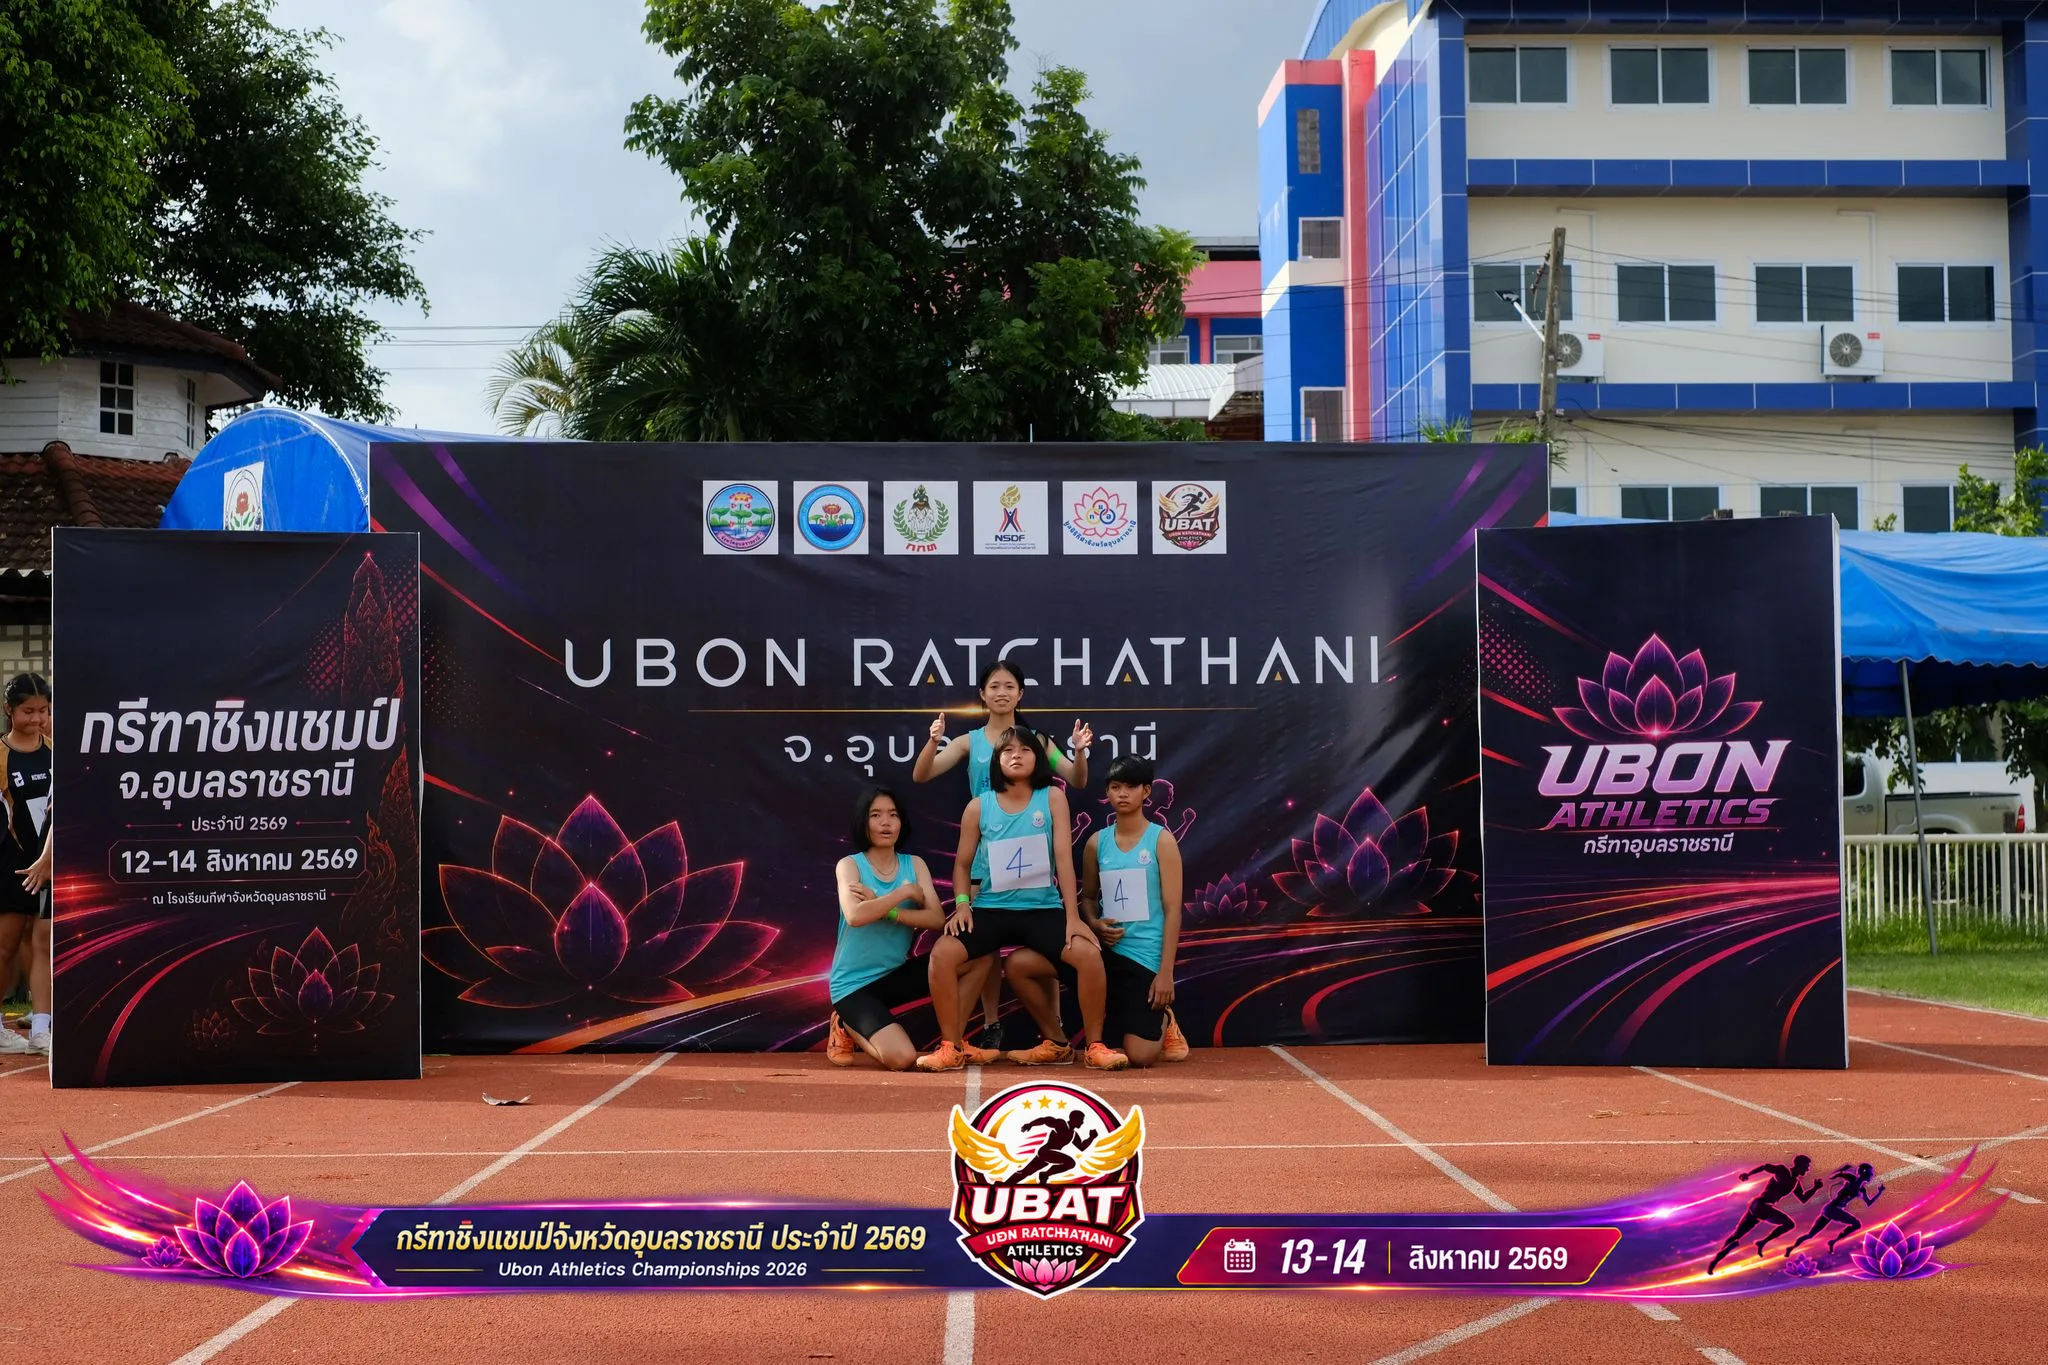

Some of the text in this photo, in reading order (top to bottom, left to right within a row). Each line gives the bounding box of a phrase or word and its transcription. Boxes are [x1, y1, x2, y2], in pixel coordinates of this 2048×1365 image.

[994, 534, 1026, 542] NSDF
[1164, 518, 1215, 531] UBAT
[564, 636, 1380, 688] UBON RATCHATHANI
[1537, 739, 1793, 797] UBON
[191, 816, 288, 832] ประจำปี 2569
[1547, 798, 1779, 829] ATHLETICS
[206, 848, 292, 872] สิงหาคม
[301, 848, 358, 870] 2569
[1005, 846, 1033, 879] 4
[1113, 878, 1129, 910] 4
